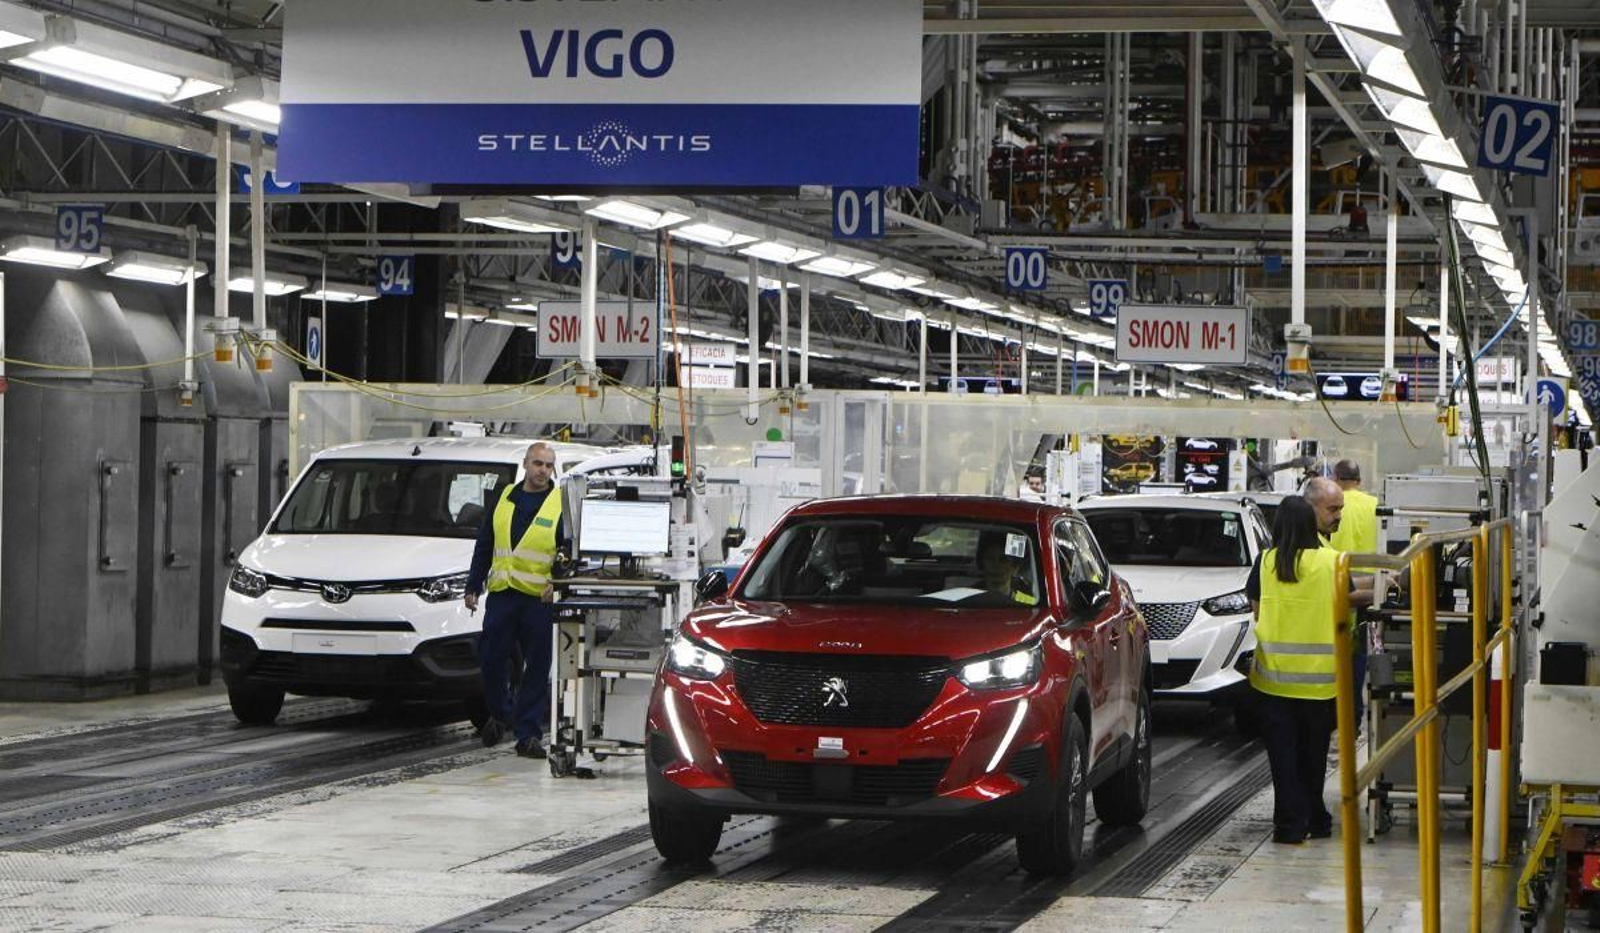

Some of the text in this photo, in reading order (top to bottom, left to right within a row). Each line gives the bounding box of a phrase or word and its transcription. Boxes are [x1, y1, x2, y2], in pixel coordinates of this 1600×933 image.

[519, 28, 674, 78] VIGO
[478, 134, 711, 151] STELLANTIS
[1484, 104, 1551, 171] 02
[838, 189, 880, 235] 01
[58, 209, 99, 251] 95
[379, 258, 410, 292] 94
[1007, 252, 1045, 287] 00
[1092, 283, 1124, 314] 99
[549, 315, 650, 343] SMN M-2
[1129, 319, 1236, 350] SMON M-1
[1571, 323, 1597, 346] 98
